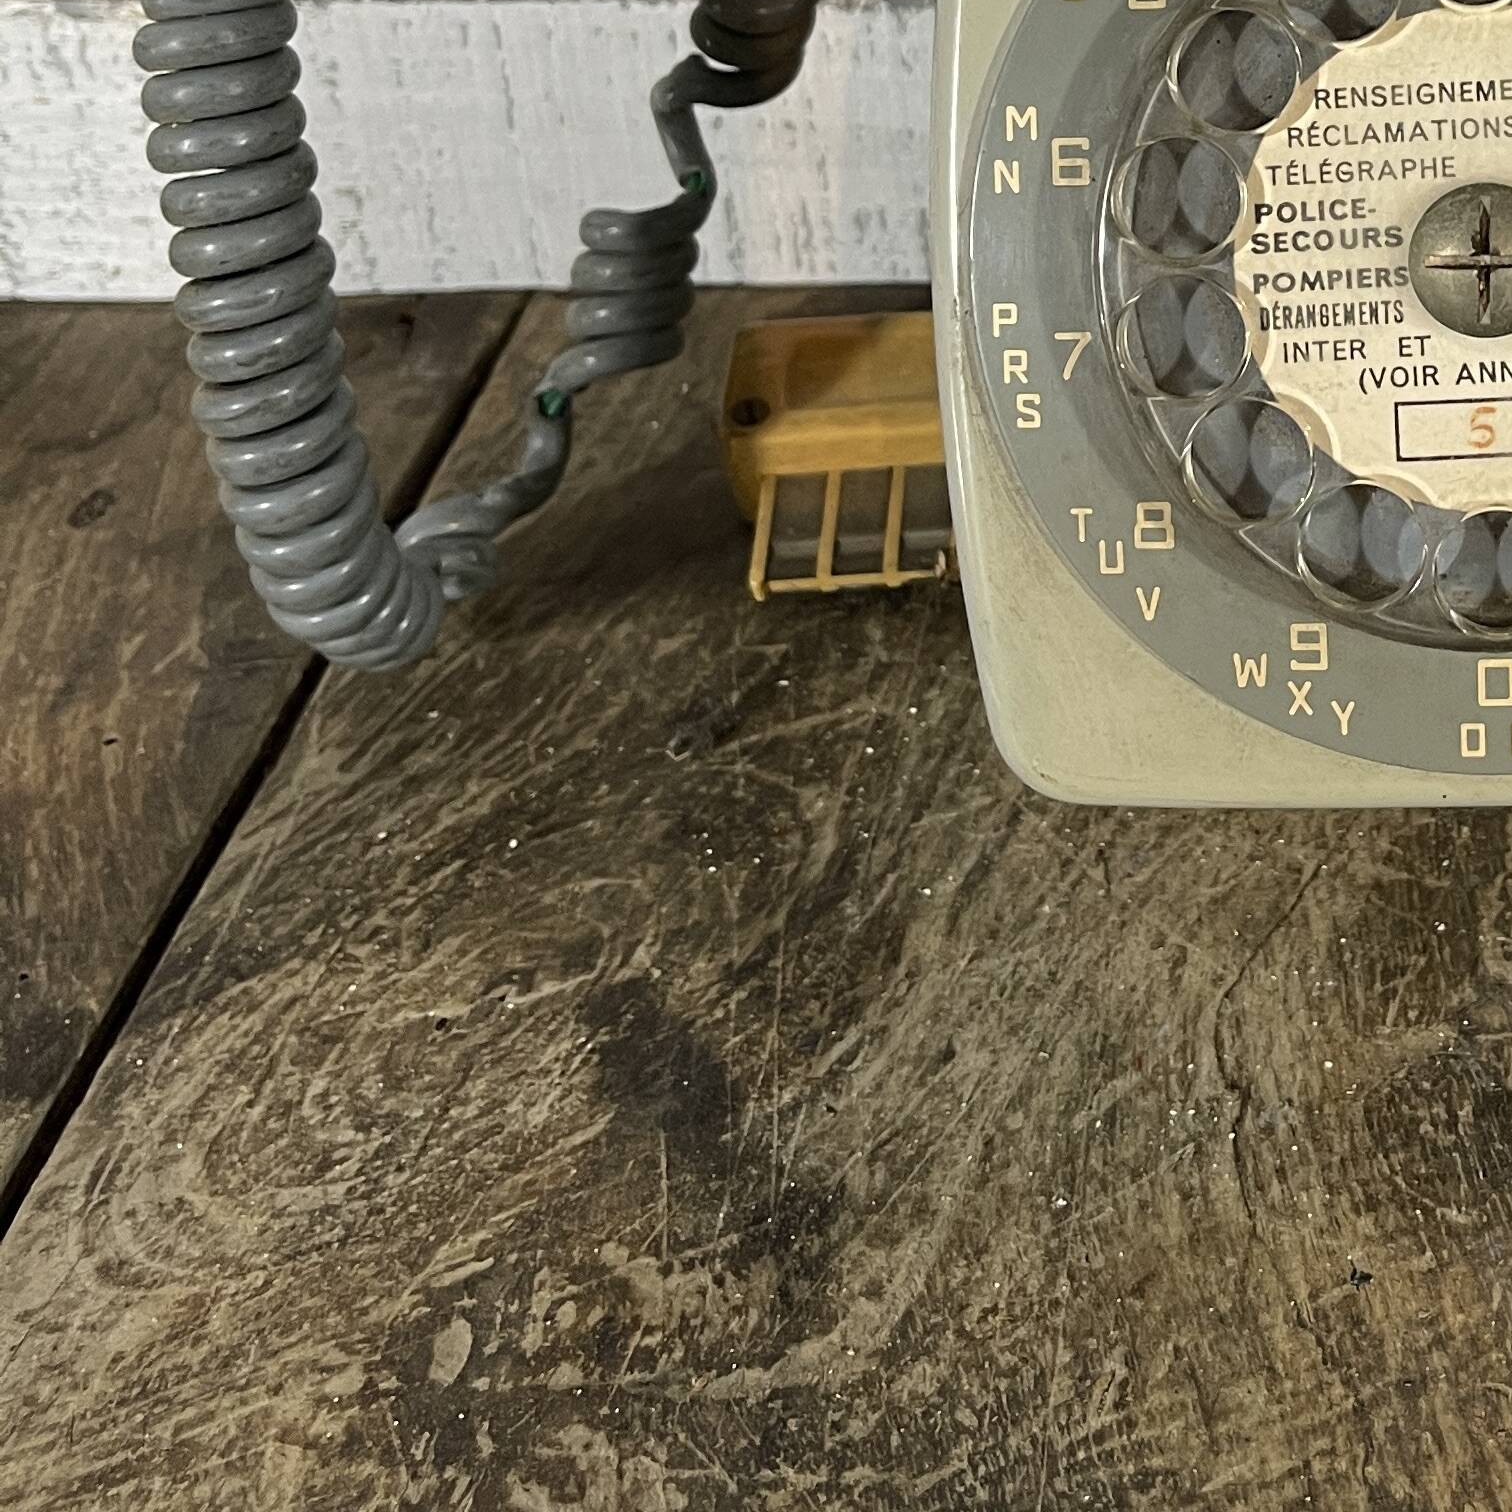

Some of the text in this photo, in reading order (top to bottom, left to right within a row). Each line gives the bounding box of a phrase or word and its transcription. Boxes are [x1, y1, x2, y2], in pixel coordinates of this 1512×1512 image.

[1051, 137, 1090, 186] 6
[1265, 156, 1456, 187] TÉLÉGRAPHE
[1254, 197, 1377, 224] POLICE-
[1251, 224, 1404, 254] SECOURS
[1253, 265, 1409, 294] POMPIERS
[1259, 299, 1405, 331] DÉRANGEMENTS
[1054, 331, 1092, 380] 7
[1282, 338, 1367, 364] INTER
[1398, 335, 1431, 358] ET
[1358, 366, 1439, 395] (VOIR
[1134, 502, 1175, 549] 8
[1290, 623, 1328, 671] 9
